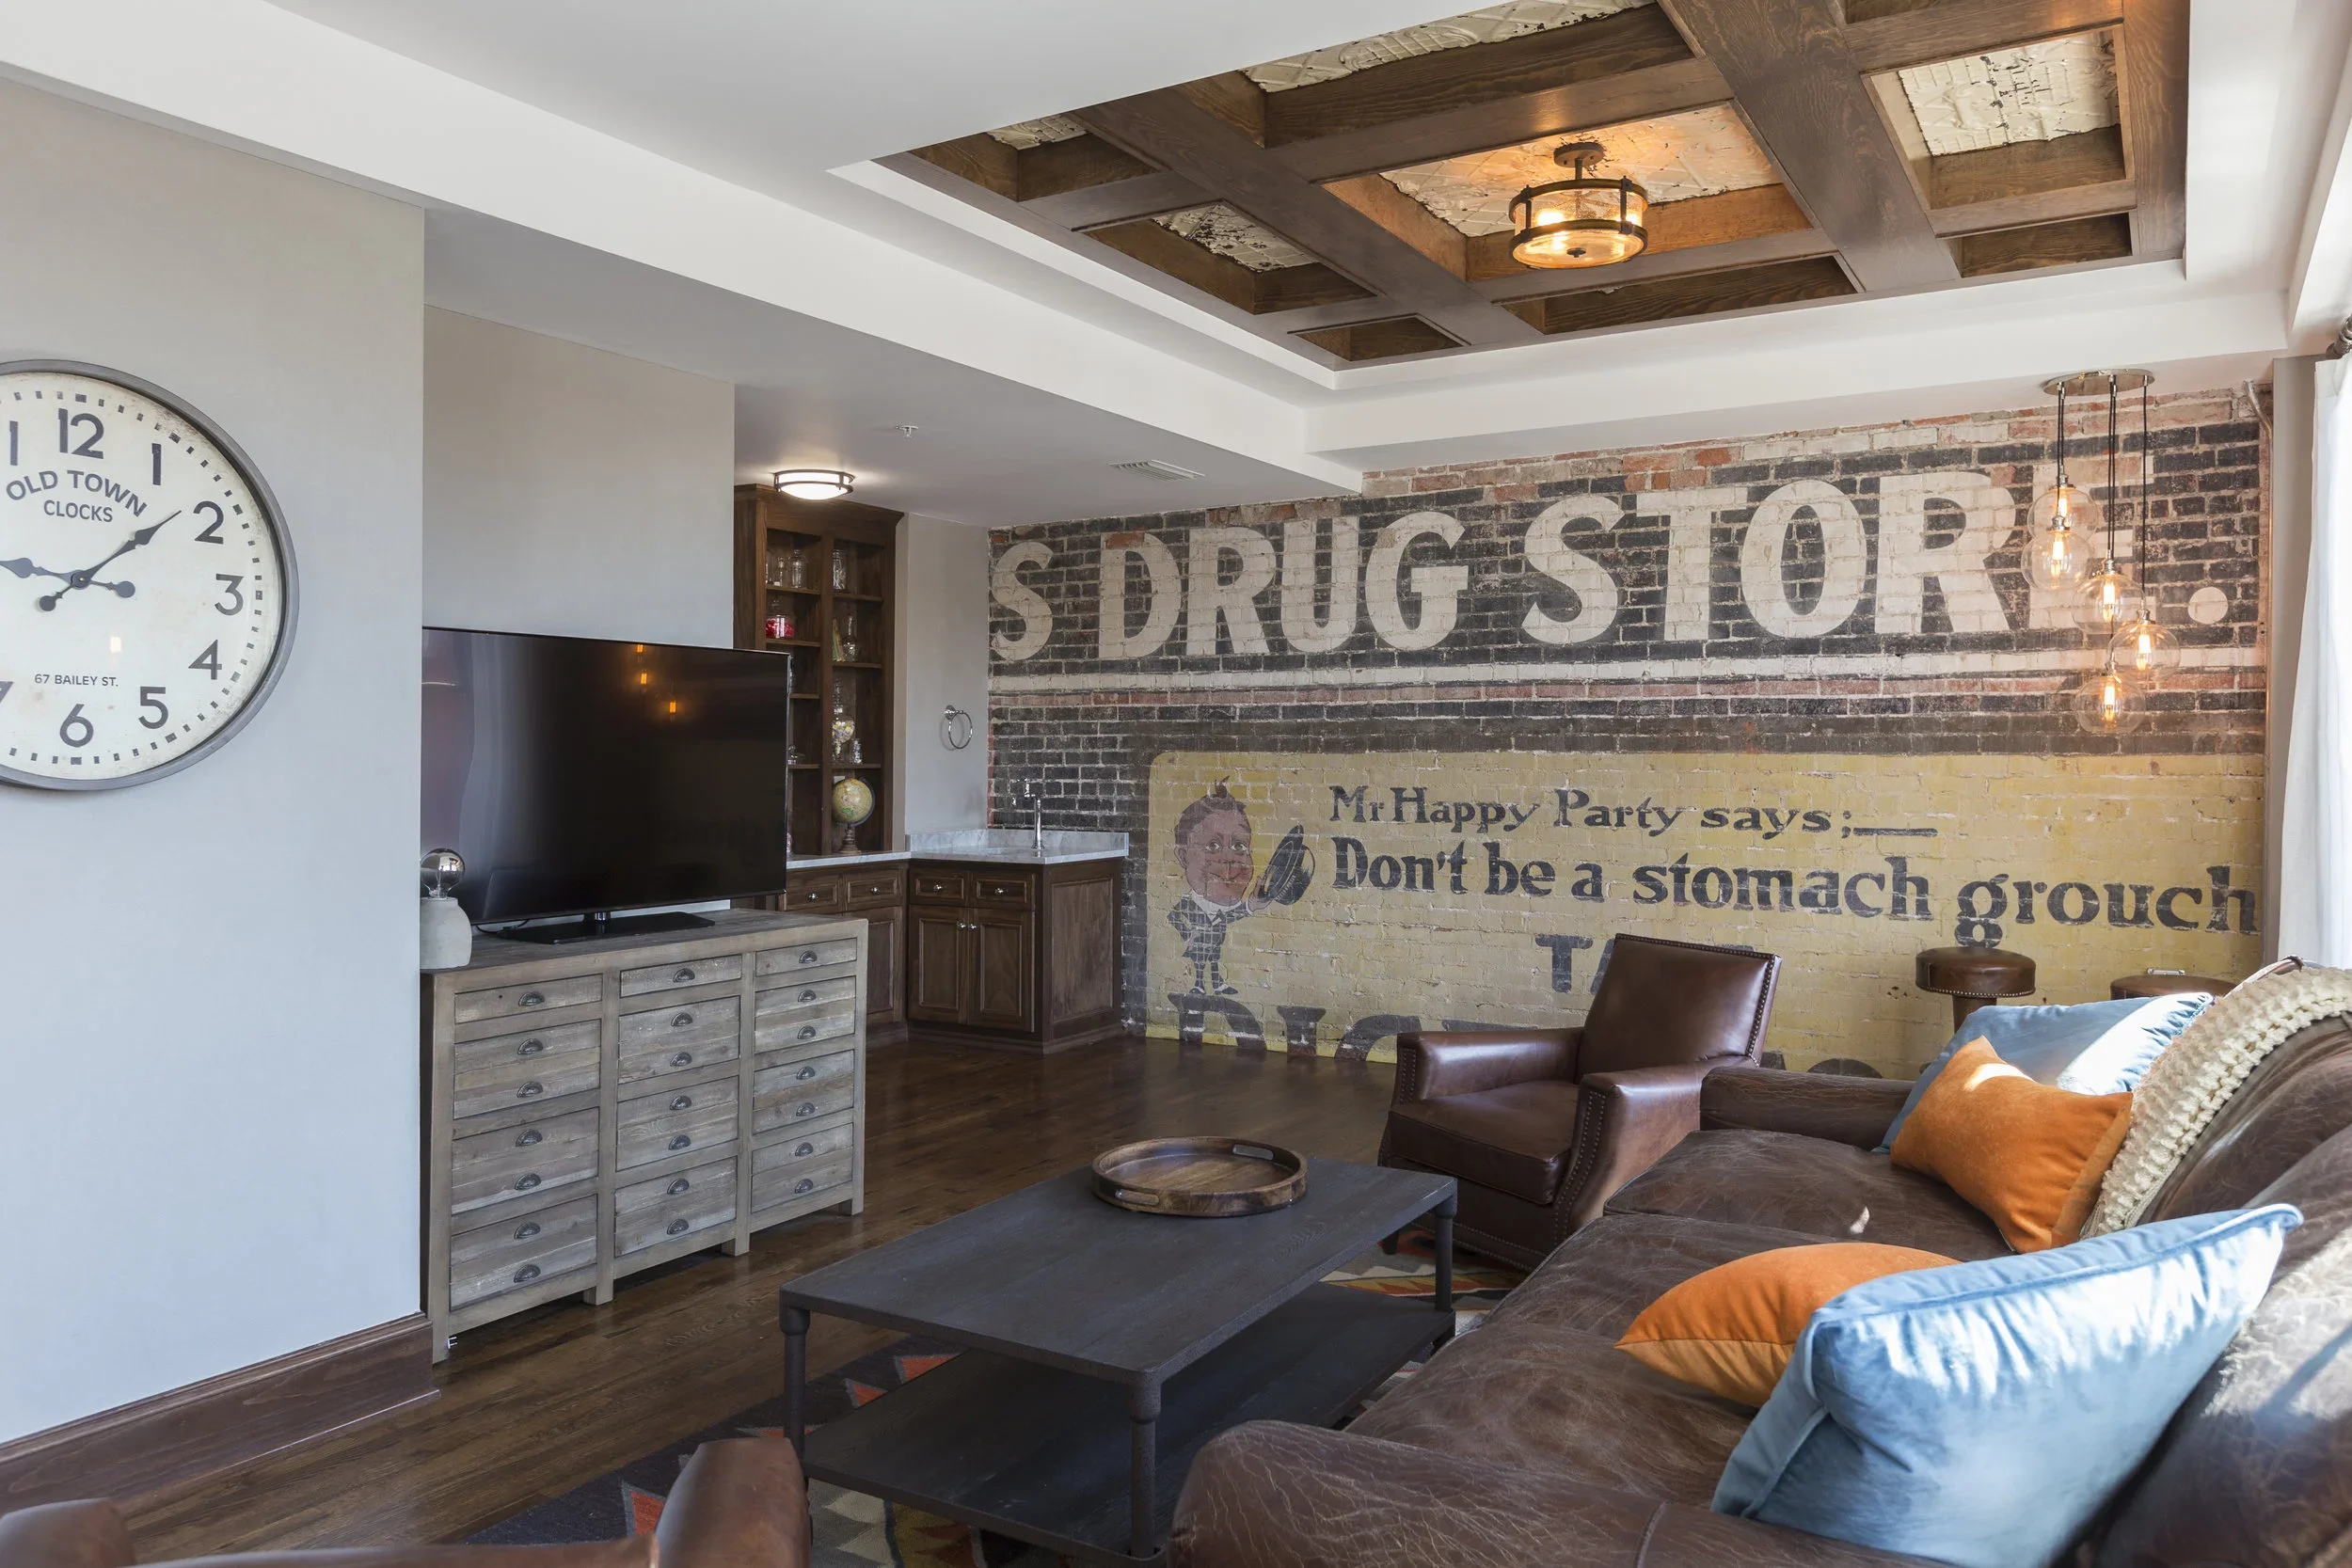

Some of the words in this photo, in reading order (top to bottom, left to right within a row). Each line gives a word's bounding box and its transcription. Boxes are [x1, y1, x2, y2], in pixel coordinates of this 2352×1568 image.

[58, 407, 104, 459] 12
[151, 443, 162, 485] 1
[6, 470, 58, 500] OLD
[67, 469, 148, 517] TOWN
[43, 499, 114, 523] CLOCKS
[193, 500, 225, 545] 2
[214, 573, 245, 616] 3
[1097, 510, 1470, 660] DRUG
[34, 673, 50, 685] 67
[55, 674, 99, 687] BAILEY
[102, 676, 119, 688] ST.
[188, 639, 223, 680] 4
[59, 704, 95, 748] 6
[138, 686, 169, 730] 5
[1389, 786, 1541, 834] Happy
[1554, 788, 1685, 837] Party
[1331, 836, 1469, 895] Don't
[1484, 841, 1557, 896] be
[1571, 863, 1604, 903] a
[1632, 851, 1934, 922] stomach
[1955, 864, 2262, 948] grouch
